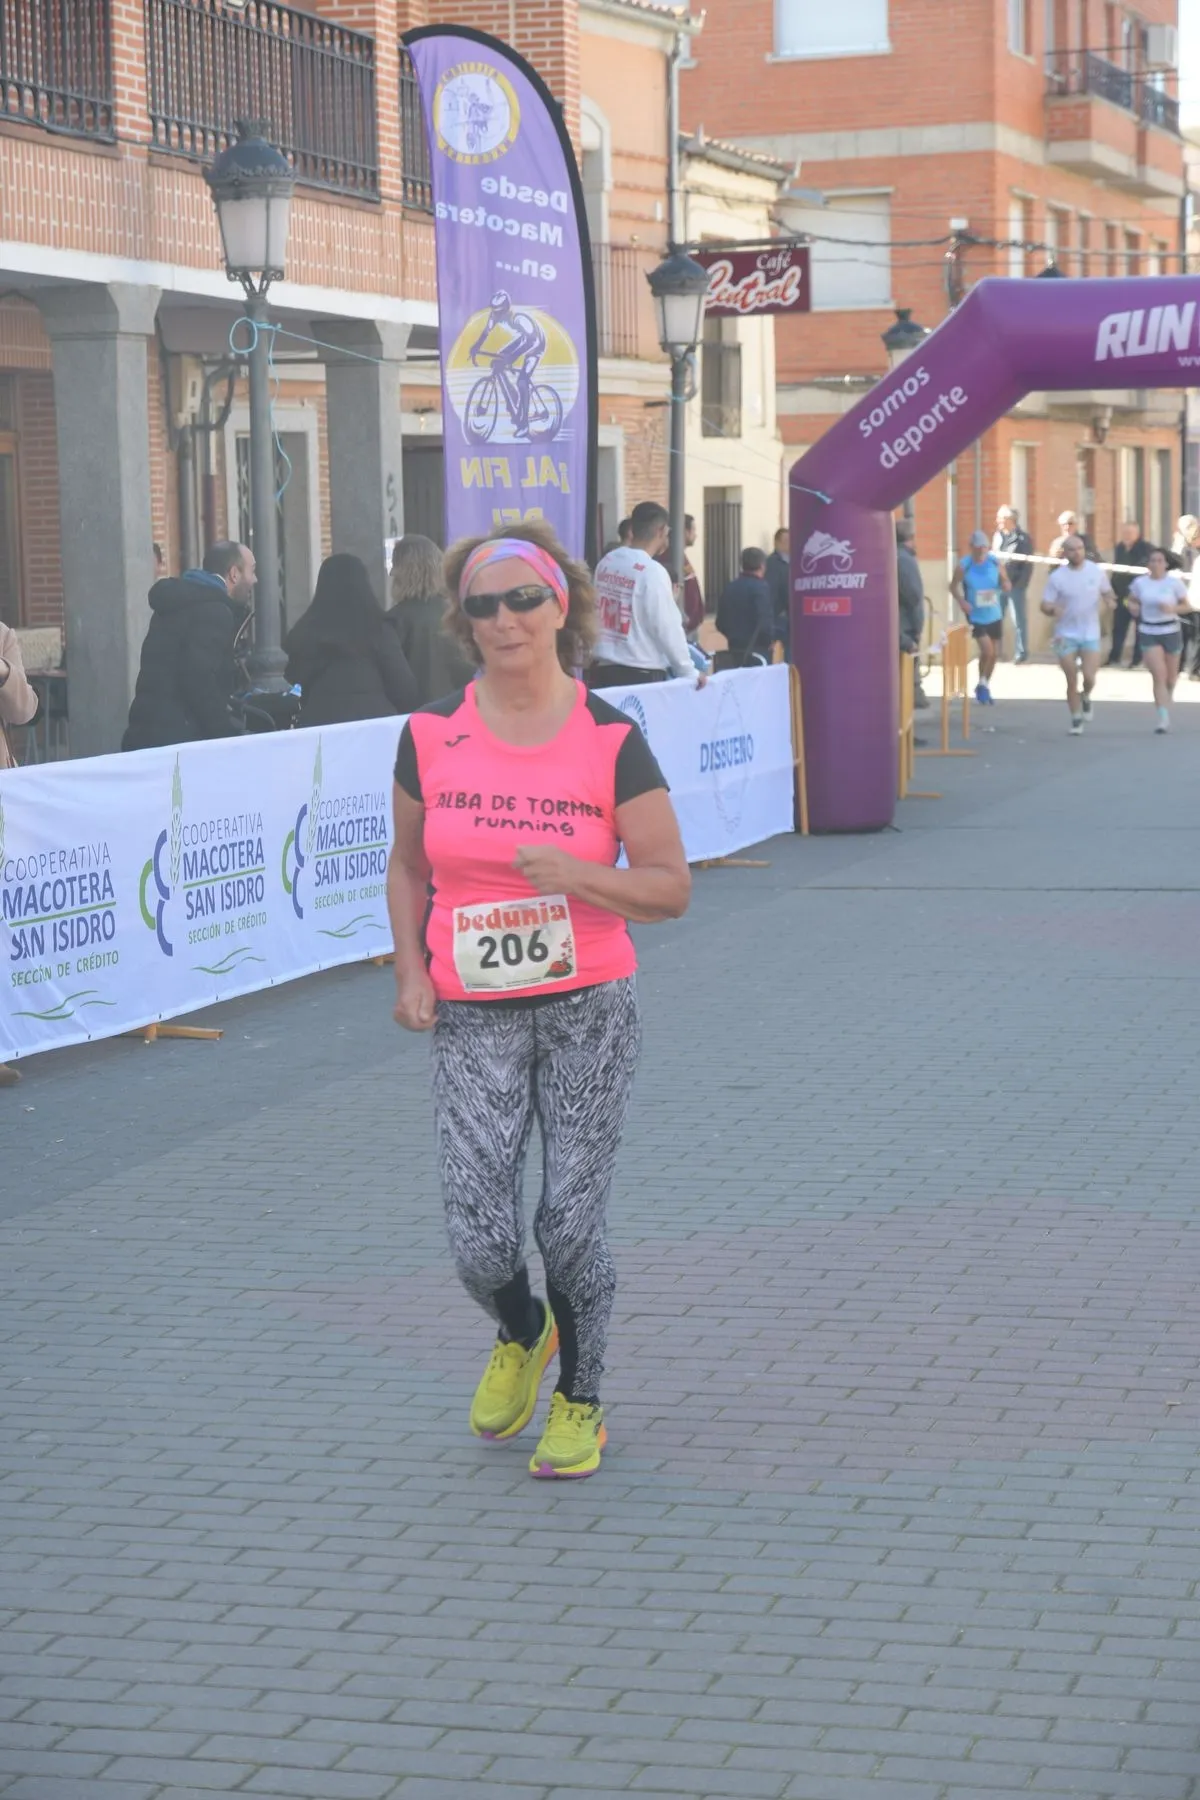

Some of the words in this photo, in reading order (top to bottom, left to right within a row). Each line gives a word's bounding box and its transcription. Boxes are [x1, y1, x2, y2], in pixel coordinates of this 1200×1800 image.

[756, 250, 793, 276] Café
[1095, 301, 1200, 361] RUN
[859, 366, 931, 438] somos
[879, 386, 969, 469] deporte
[320, 791, 386, 820] COOPERATIVA
[435, 791, 482, 810] ALBA
[491, 795, 516, 811] DE
[182, 811, 264, 847] COOPERATIVA
[316, 815, 387, 851] MACOTERA
[474, 815, 575, 837] running
[4, 842, 111, 883] COOPERATIVA
[183, 837, 264, 880] MACOTERA
[314, 857, 340, 887] SAN
[345, 848, 387, 881] ISIDRO
[2, 869, 115, 920] MACOTERA
[186, 885, 215, 920] SAN
[220, 874, 264, 912] ISIDRO
[314, 889, 344, 909] SECCIÓN
[348, 888, 357, 902] DE
[10, 925, 44, 960] SAN
[53, 910, 115, 953] ISIDRO
[188, 922, 220, 945] SECCIÓN
[225, 920, 235, 935] DE
[238, 912, 267, 931] CRÉDITO
[457, 902, 567, 933] bedunia
[57, 962, 70, 978] DE
[76, 951, 119, 973] CRÉDITO
[477, 929, 549, 970] 206
